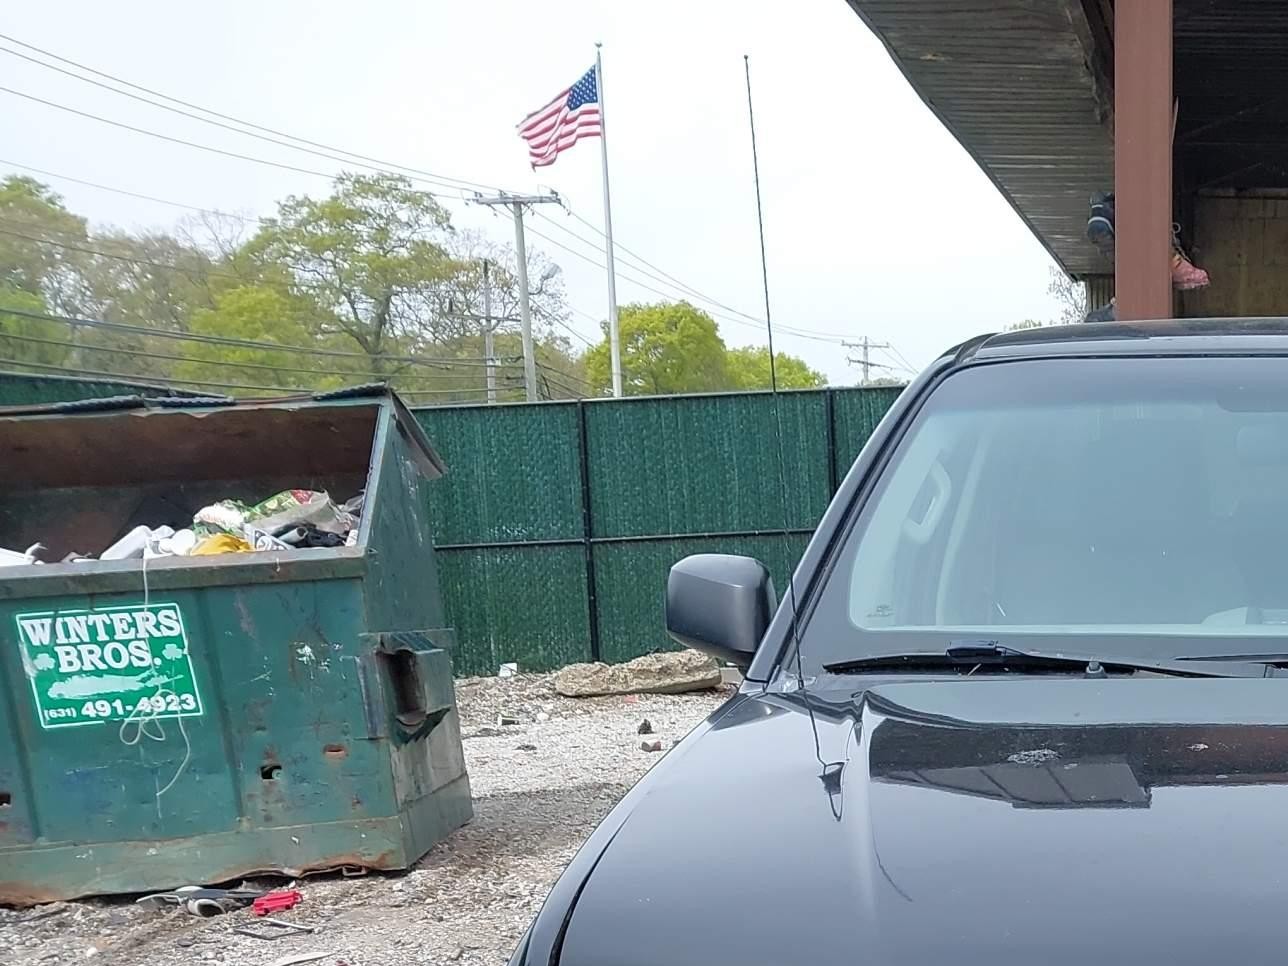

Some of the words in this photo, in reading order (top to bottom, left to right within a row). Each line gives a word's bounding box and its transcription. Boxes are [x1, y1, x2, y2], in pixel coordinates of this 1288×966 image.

[21, 609, 181, 645] WINTERS
[54, 640, 162, 672] BROS.
[43, 707, 77, 719] (631)
[81, 694, 197, 718] 491-4923
